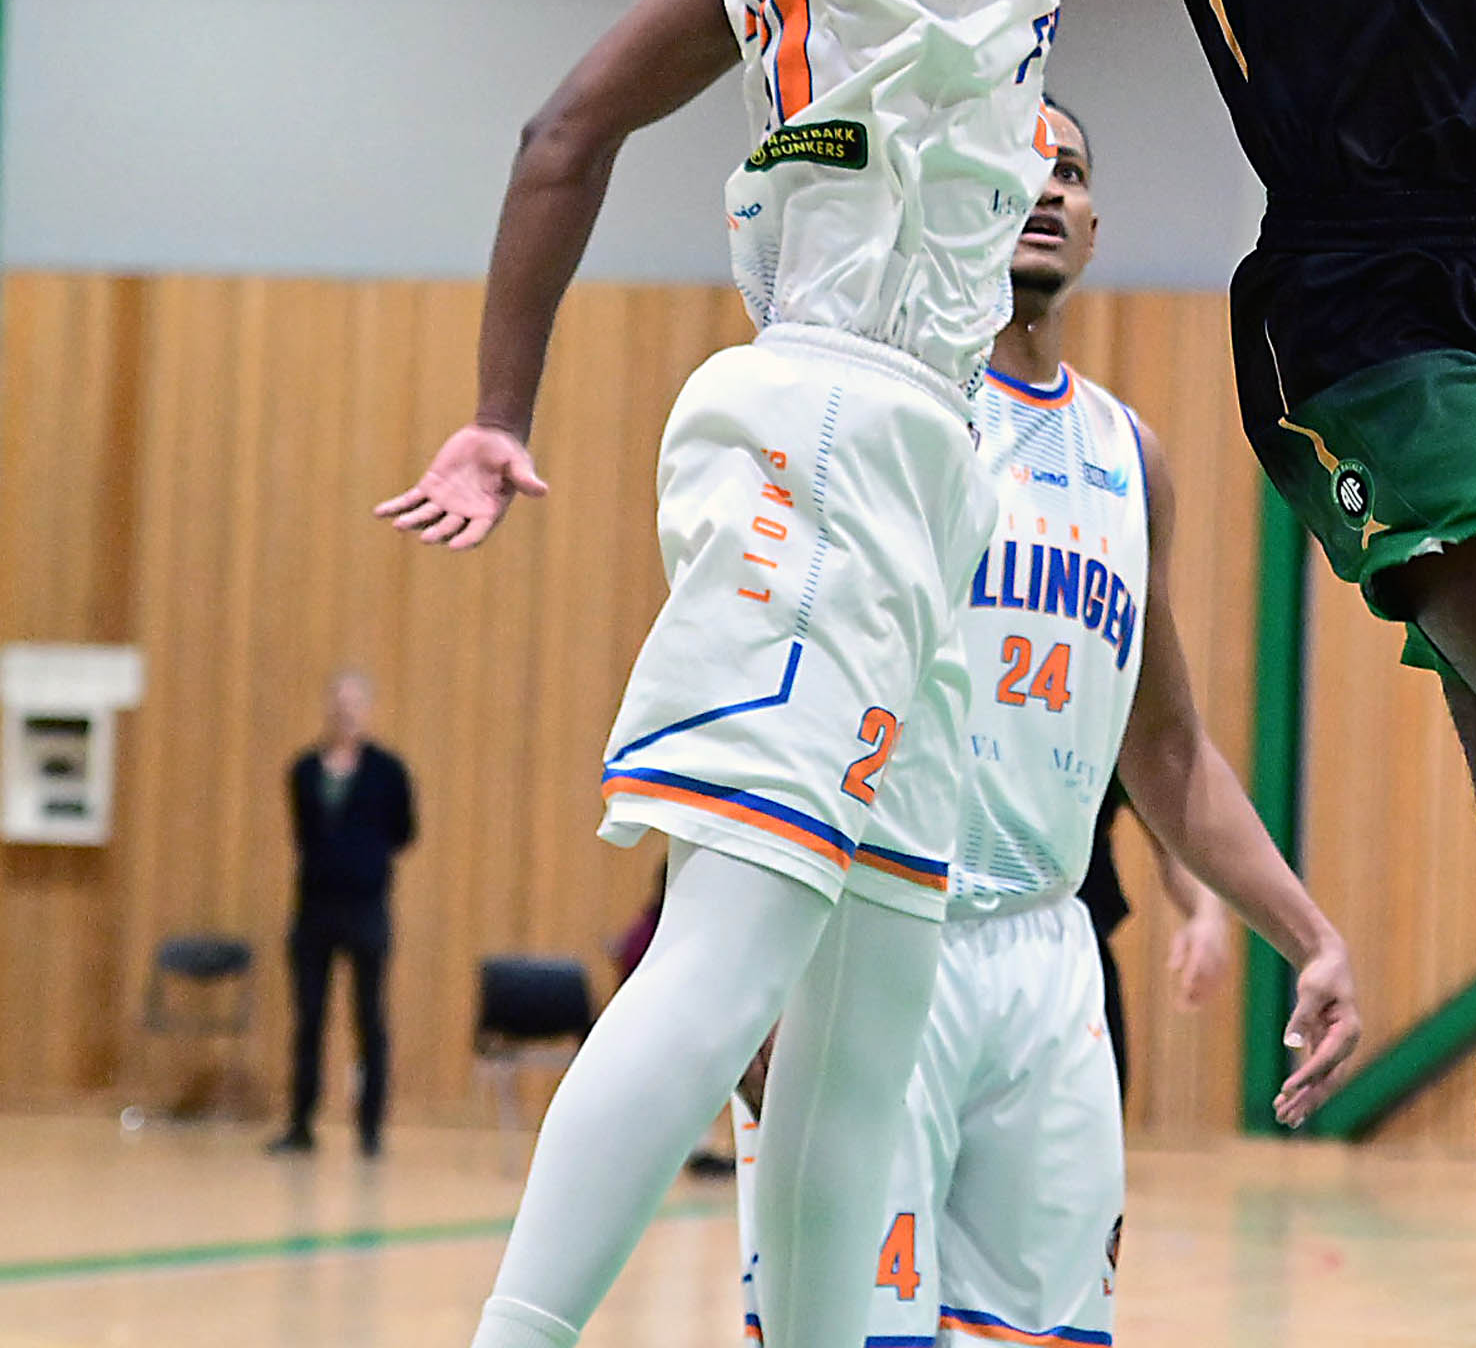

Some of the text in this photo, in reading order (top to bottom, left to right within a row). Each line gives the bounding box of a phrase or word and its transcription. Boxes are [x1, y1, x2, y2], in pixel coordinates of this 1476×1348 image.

[769, 141, 845, 158] BUNKERS
[996, 634, 1072, 714] 24
[874, 1212, 922, 1301] 4
